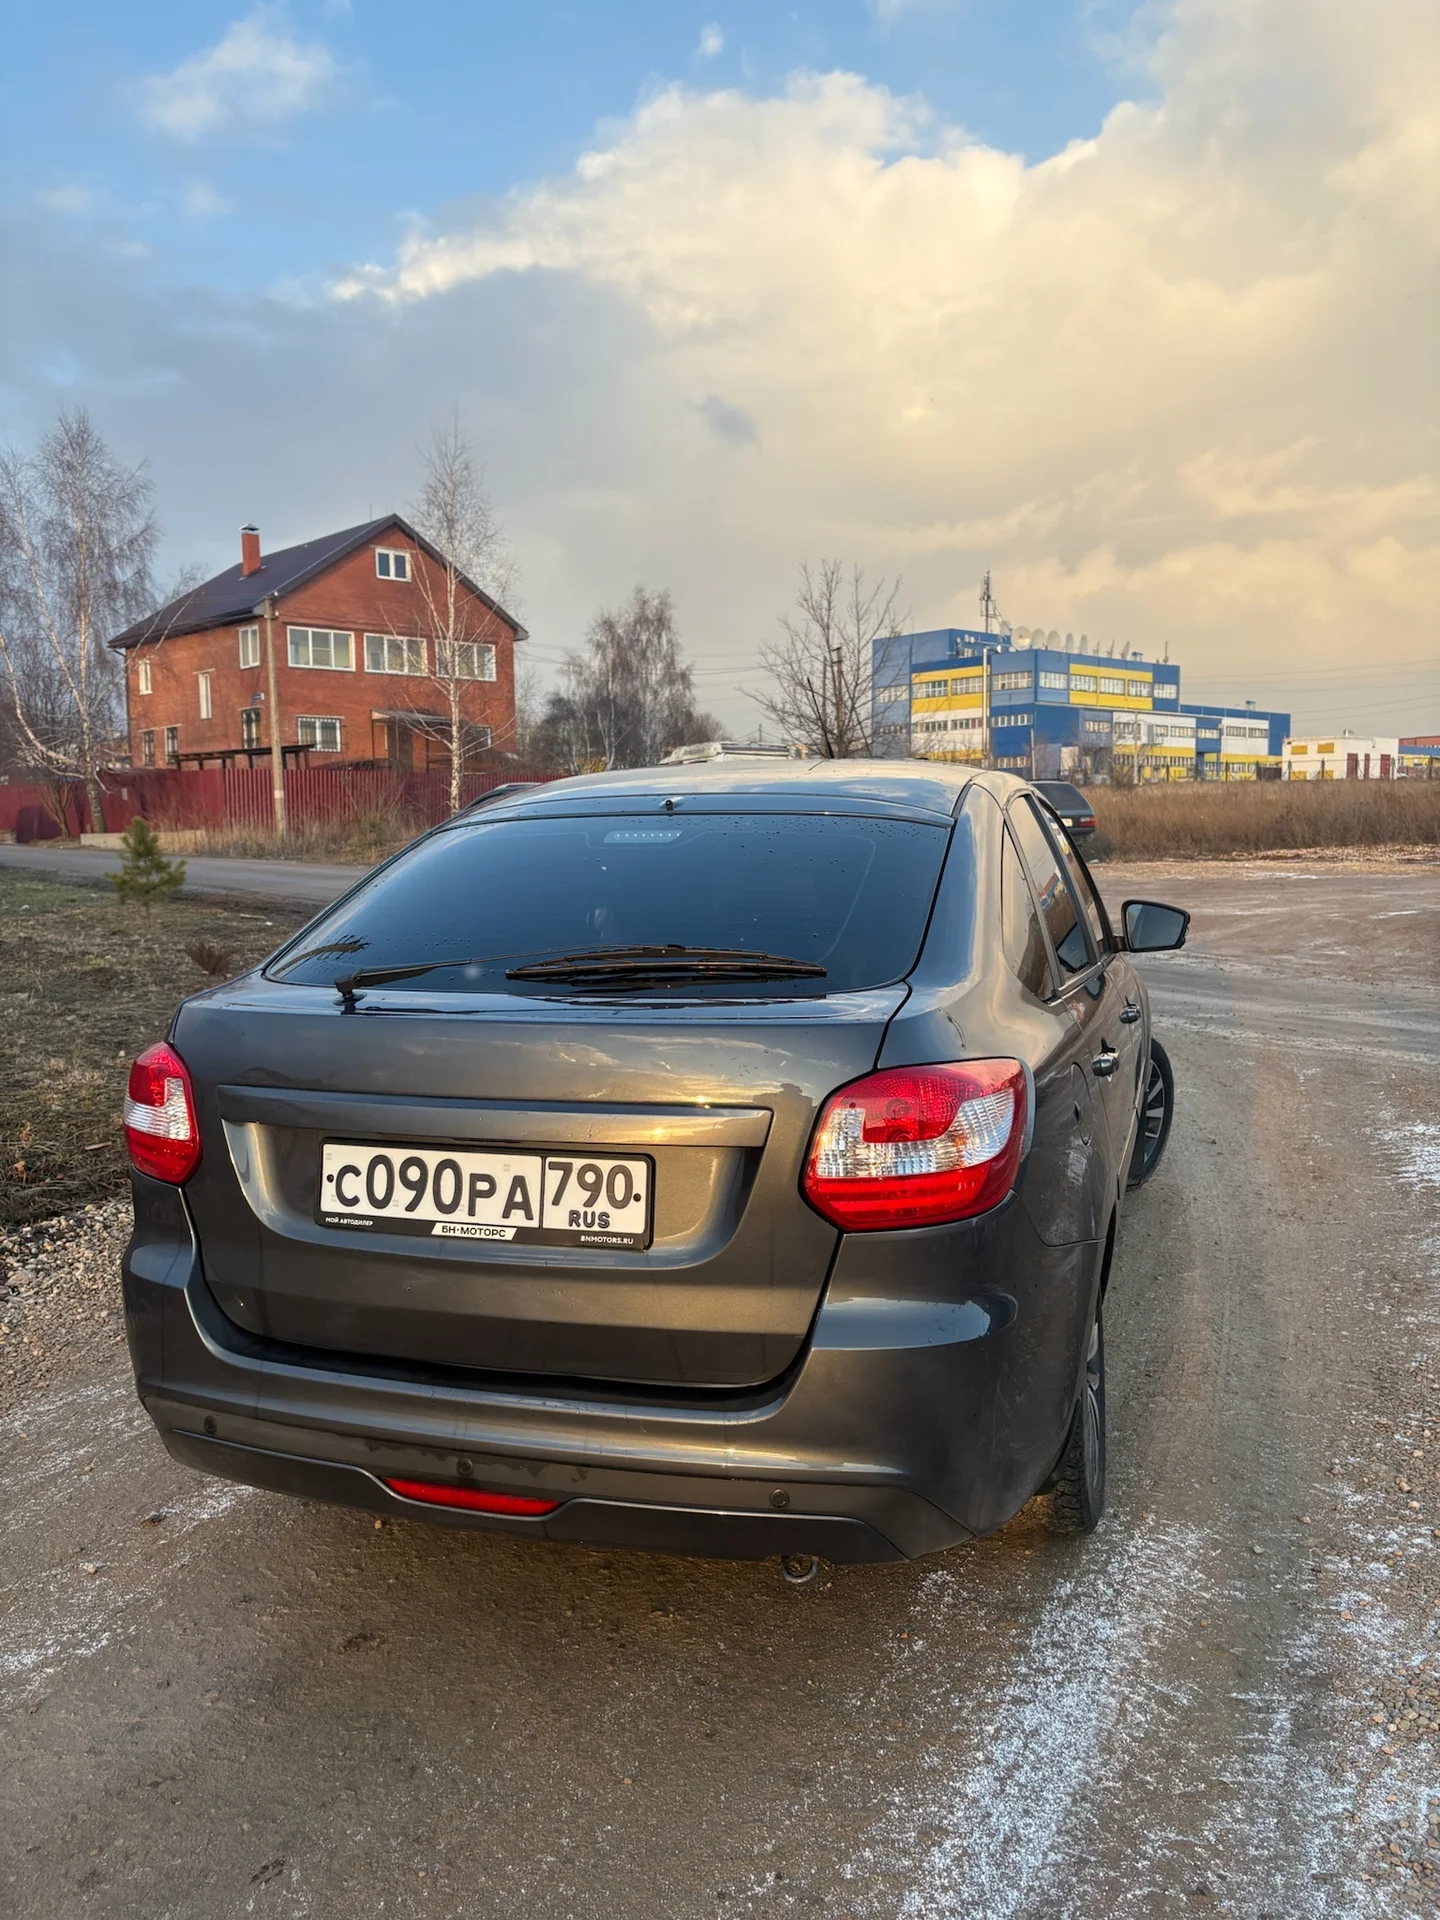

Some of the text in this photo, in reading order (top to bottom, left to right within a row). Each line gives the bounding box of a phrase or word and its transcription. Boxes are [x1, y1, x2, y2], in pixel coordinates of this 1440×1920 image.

[547, 1161, 634, 1210] 790
[325, 1216, 374, 1227] МОЙ АВТОДИЛЕР
[568, 1209, 611, 1229] RUS
[580, 1235, 634, 1245] BNMOTORS.RU
